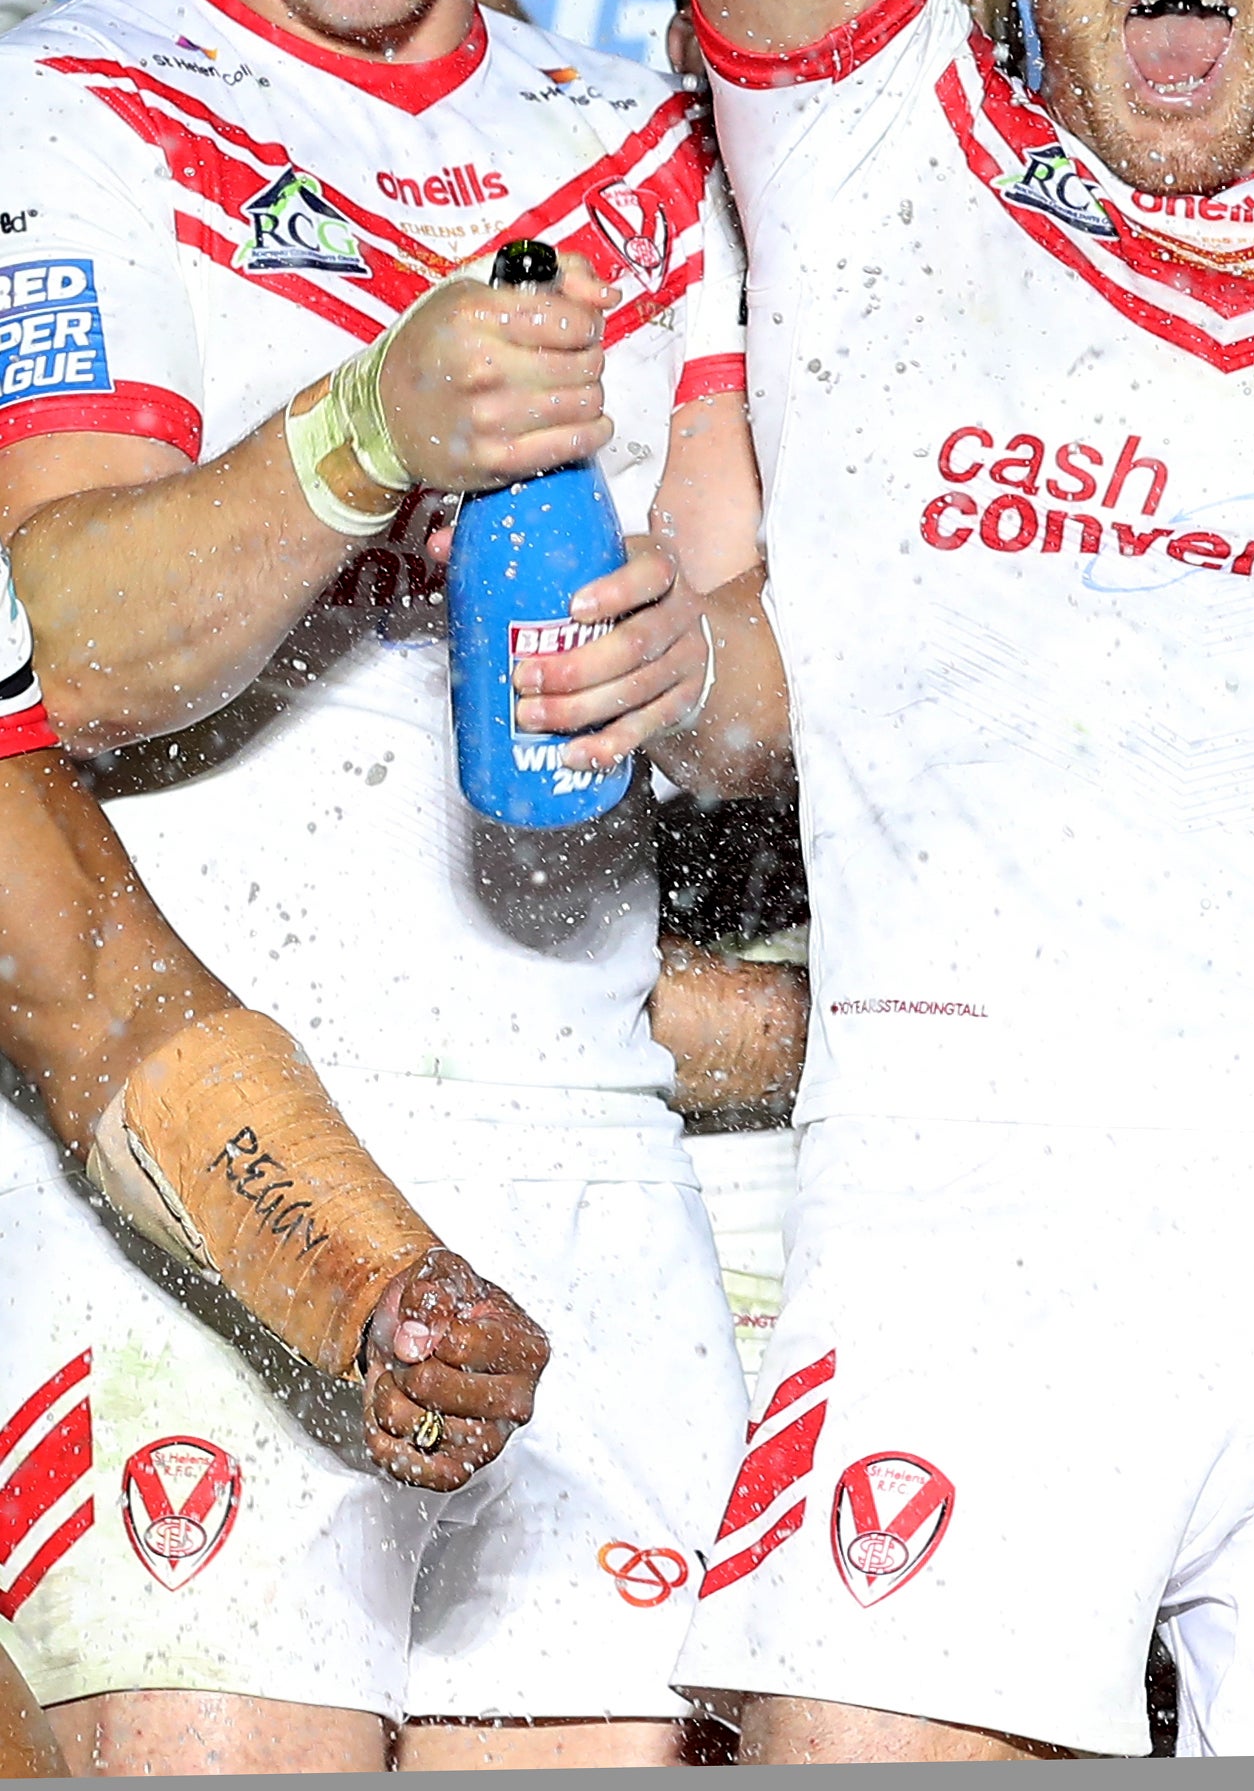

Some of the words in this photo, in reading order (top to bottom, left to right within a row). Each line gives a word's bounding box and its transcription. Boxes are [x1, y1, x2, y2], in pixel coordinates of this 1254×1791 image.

[1020, 157, 1107, 214] RC
[248, 211, 357, 257] RCG
[936, 425, 1169, 516] cash
[514, 621, 615, 655] BET
[206, 1125, 331, 1262] REGGY
